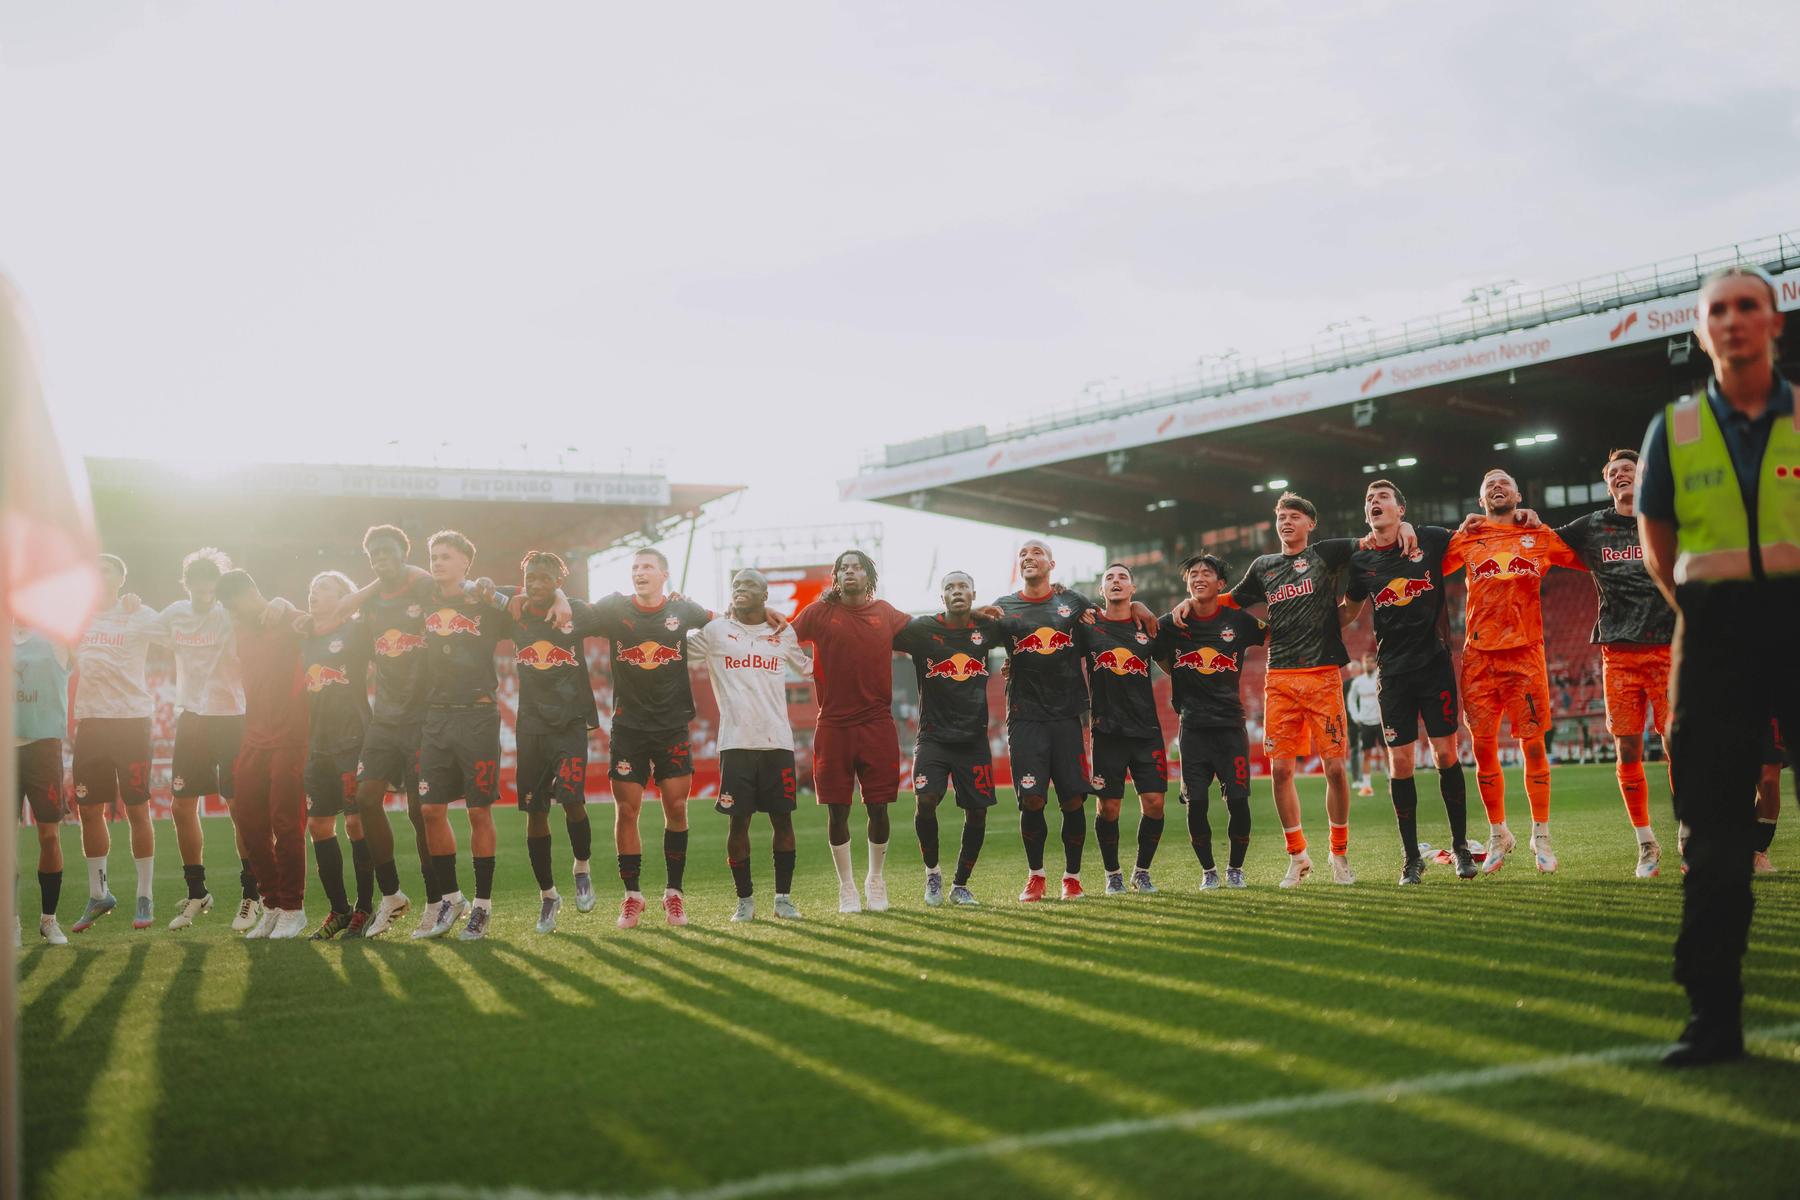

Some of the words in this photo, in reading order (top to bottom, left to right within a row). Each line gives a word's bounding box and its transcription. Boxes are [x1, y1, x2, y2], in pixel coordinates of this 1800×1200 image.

[1391, 352, 1497, 384] Sparebanken
[1499, 337, 1551, 359] Norge
[1602, 545, 1632, 562] Red
[1285, 578, 1313, 599] Bull
[100, 632, 124, 647] Bull
[725, 654, 750, 670] Red
[752, 655, 778, 671] Bull
[16, 688, 38, 704] Bull
[475, 759, 497, 785] 27
[560, 757, 583, 782] 45
